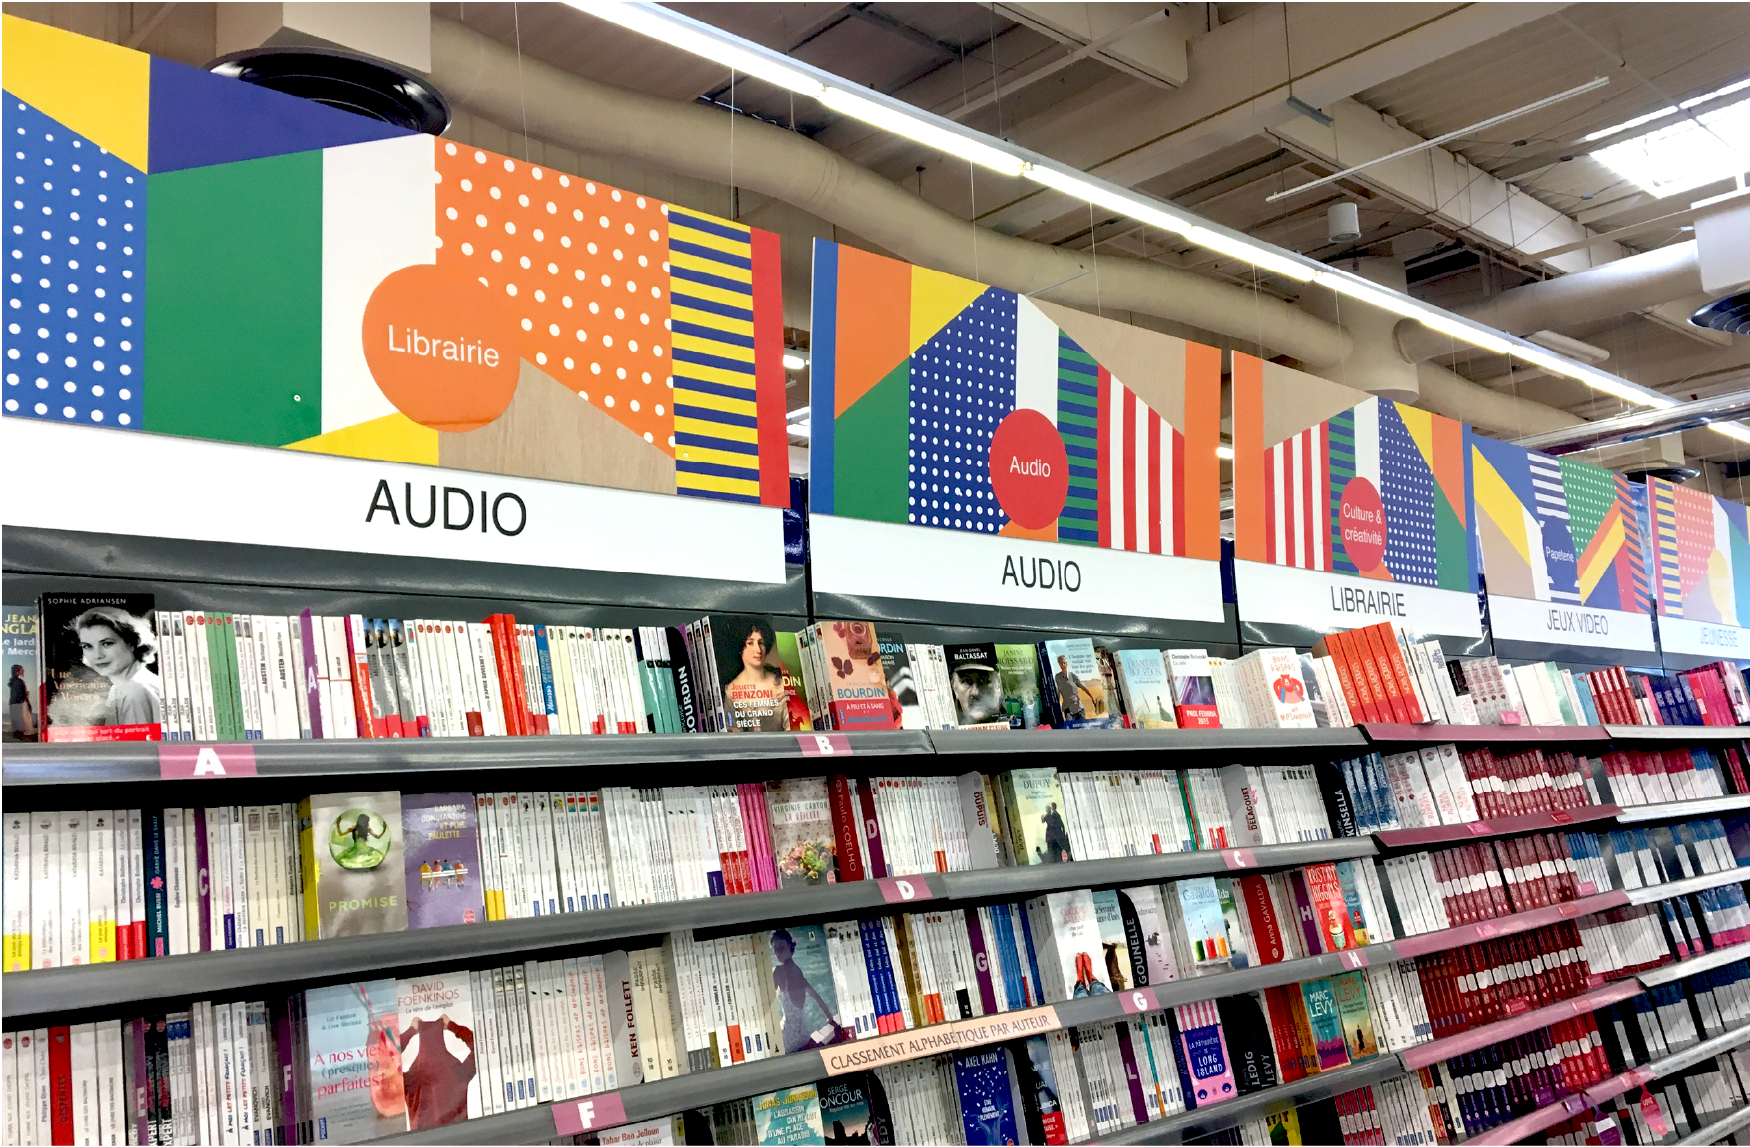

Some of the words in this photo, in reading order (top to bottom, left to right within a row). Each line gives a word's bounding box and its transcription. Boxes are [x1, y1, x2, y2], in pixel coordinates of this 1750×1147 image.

[388, 324, 500, 367] Librairie
[1010, 456, 1051, 477] Audio
[365, 479, 527, 537] AUDIO
[1343, 503, 1374, 522] Culture
[1376, 510, 1382, 524] &
[1344, 526, 1382, 546] créativité
[1546, 546, 1574, 563] Papeterie
[1002, 555, 1081, 592] AUDIO
[1331, 586, 1406, 617] LIBRAIRIE
[1547, 609, 1576, 632] JEUX
[1576, 612, 1608, 636] VIDEO
[1700, 627, 1739, 648] JEUNESSE
[954, 652, 988, 660] BALTASSAT
[1272, 655, 1290, 663] BONS
[260, 662, 268, 686] AUSTEN
[278, 658, 286, 680] AUSTEN
[308, 666, 318, 694] A
[1387, 680, 1397, 698] NORA
[1400, 676, 1410, 694] NORA
[678, 666, 697, 733] BOURDIN
[732, 690, 774, 700] BENZONI
[837, 688, 885, 699] BOURDIN
[1346, 688, 1356, 707] NORA
[1360, 686, 1370, 704] NORA
[1374, 682, 1384, 700] NORA
[748, 710, 774, 718] GRAND
[750, 700, 780, 708] FEMMES
[1198, 710, 1218, 718] FEMINA
[736, 719, 762, 728] SIÈCLE
[1197, 717, 1210, 725] 2015
[814, 735, 835, 755] B
[194, 748, 226, 776] A
[1023, 778, 1051, 790] DUPUY
[774, 804, 801, 814] VIRGINIE
[805, 802, 828, 810] CARTON
[784, 814, 792, 822] LA
[973, 791, 986, 827] DUPUIS
[1240, 787, 1258, 830] DELACOURT
[1334, 789, 1355, 837] KINSELLA
[837, 794, 846, 824] Paulo
[842, 825, 857, 872] COELHO
[865, 818, 878, 840] D
[1233, 850, 1247, 868] C
[198, 868, 208, 896] C
[894, 880, 915, 900] D
[328, 894, 398, 913] PROMISE
[1182, 888, 1215, 902] Gavalda
[1258, 884, 1271, 922] GAVALDA
[1300, 905, 1314, 922] H
[1266, 924, 1276, 946] Anna
[1126, 918, 1148, 984] GOUNELLE
[1350, 952, 1362, 968] H
[976, 952, 988, 972] G
[412, 982, 444, 995] DAVID
[1339, 976, 1356, 986] MARC
[397, 988, 460, 1007] FOENKINOS
[622, 980, 636, 1028] FOLLETT
[712, 985, 720, 1005] FOWLER
[1133, 992, 1148, 1012] G
[1309, 990, 1329, 1003] MARC
[1340, 986, 1362, 1002] LEVY
[336, 1013, 356, 1021] Fenton
[1308, 999, 1334, 1018] LEVY
[628, 1032, 639, 1058] KEN
[831, 1042, 906, 1070] CLASSEMENT
[990, 1022, 1009, 1037] PAR
[1011, 1015, 1050, 1033] AUTEUR
[1188, 1042, 1195, 1050] LA
[314, 1050, 326, 1066] À
[328, 1050, 354, 1064] nos
[357, 1045, 384, 1058] vies
[966, 1056, 980, 1068] AXEL
[981, 1052, 999, 1066] KAHN
[1198, 1054, 1218, 1068] LONG
[283, 1064, 292, 1092] F
[322, 1059, 380, 1080] (presque)
[1126, 1063, 1138, 1080] L
[1196, 1064, 1224, 1078] ISLAND
[1247, 1050, 1260, 1086] LEDIG
[1261, 1054, 1275, 1082] LEVY
[317, 1073, 380, 1100] parfaites
[828, 1084, 848, 1096] SERGE
[136, 1086, 146, 1118] E
[252, 1086, 260, 1122] EVANOVICH
[264, 1085, 272, 1120] EVANOVICH
[756, 1098, 780, 1111] JONAS
[820, 1089, 864, 1110] ONCOUR
[226, 1114, 234, 1126] MOI
[577, 1100, 596, 1129] F
[786, 1116, 797, 1124] QUI
[318, 1117, 328, 1140] POCKET
[602, 1134, 620, 1144] Tahar
[621, 1131, 635, 1141] Ben
[635, 1128, 660, 1139] Jelloun
[768, 1128, 784, 1138] D'UNE
[784, 1123, 804, 1134] PLACE
[777, 1136, 786, 1144] AU
